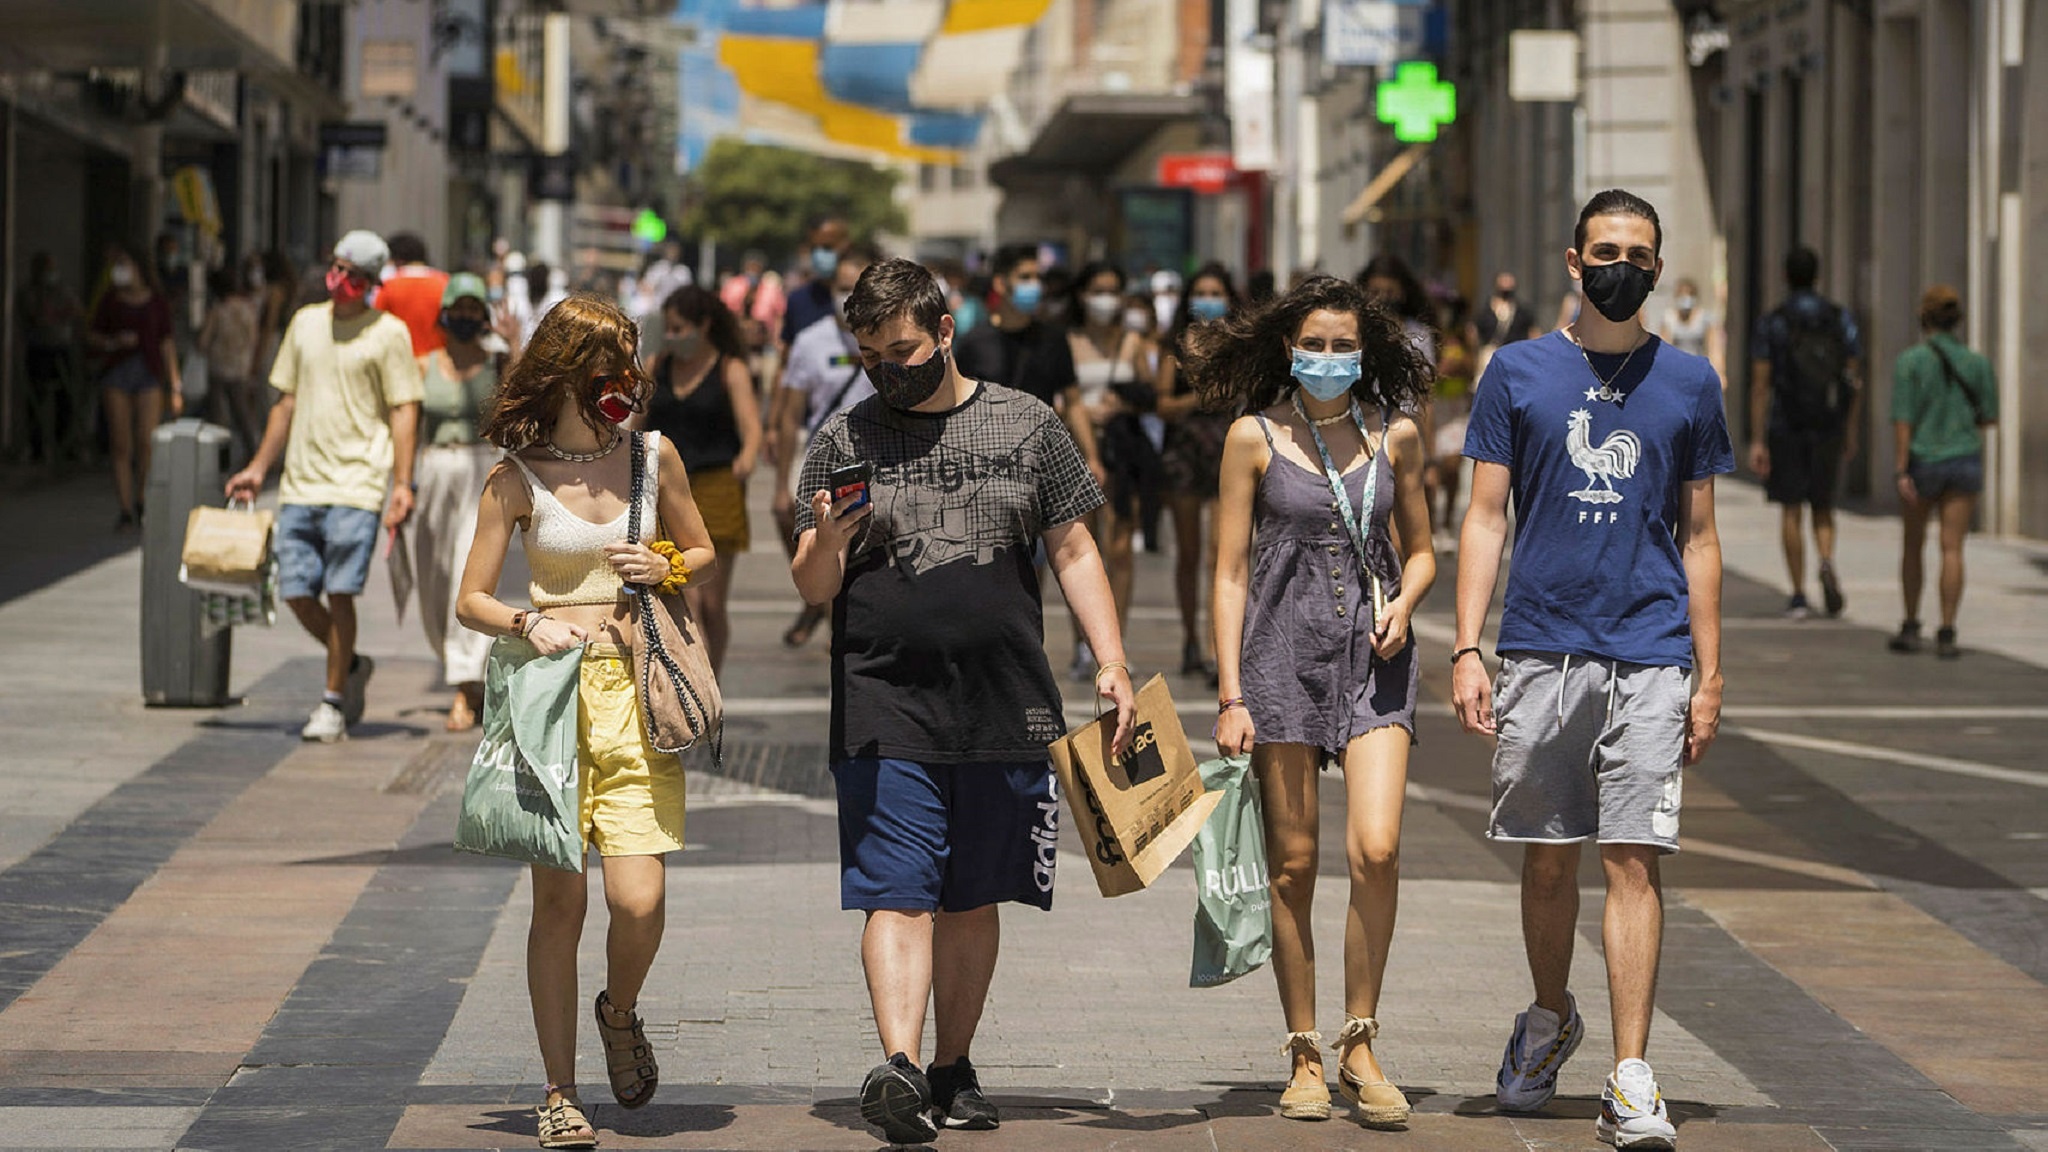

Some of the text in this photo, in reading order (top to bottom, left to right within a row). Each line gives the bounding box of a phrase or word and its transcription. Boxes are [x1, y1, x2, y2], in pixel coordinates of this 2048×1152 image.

[1578, 511, 1618, 524] FFF
[1121, 728, 1157, 763] nac
[1030, 759, 1059, 893] adid
